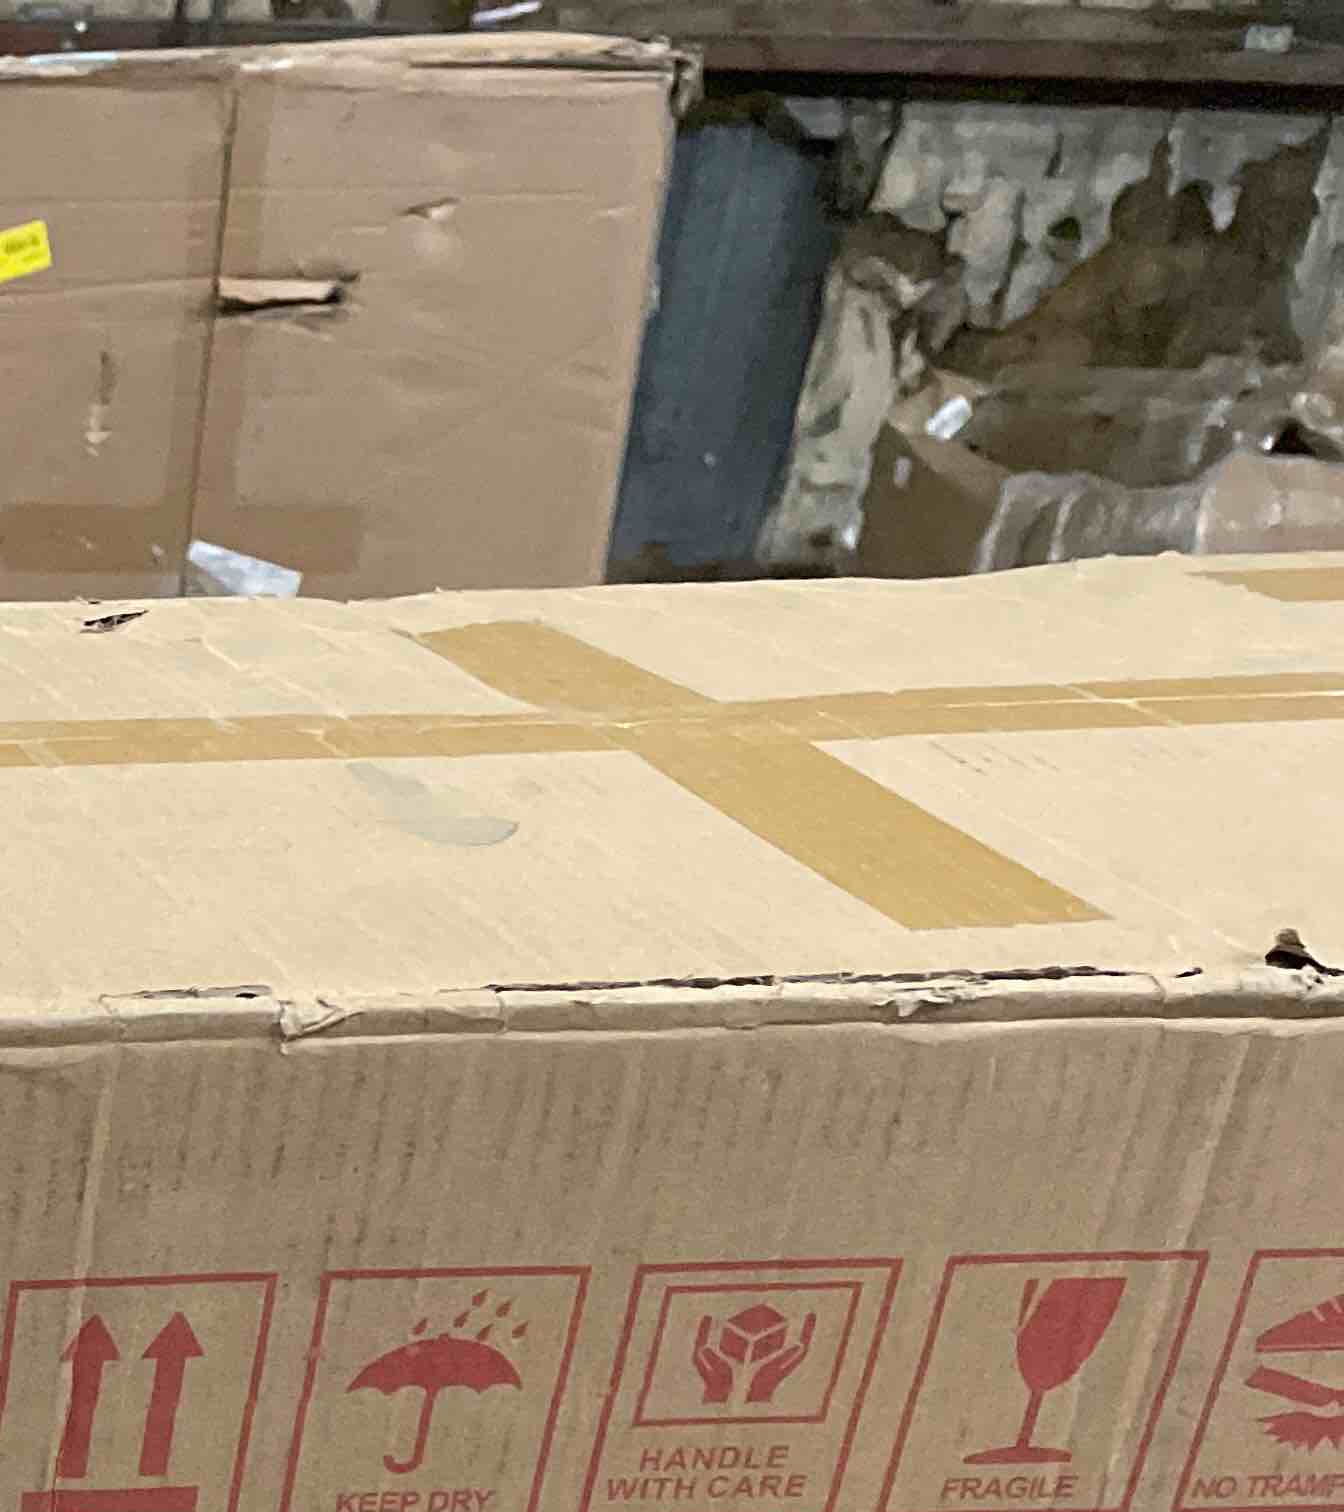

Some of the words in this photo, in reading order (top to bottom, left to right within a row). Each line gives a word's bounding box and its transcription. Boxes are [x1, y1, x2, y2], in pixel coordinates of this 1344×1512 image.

[638, 1443, 790, 1473] HANDLE
[607, 1475, 697, 1501] WITH
[706, 1473, 809, 1500] CARE
[939, 1474, 1080, 1501] FRAGILE
[1191, 1475, 1238, 1501] NO
